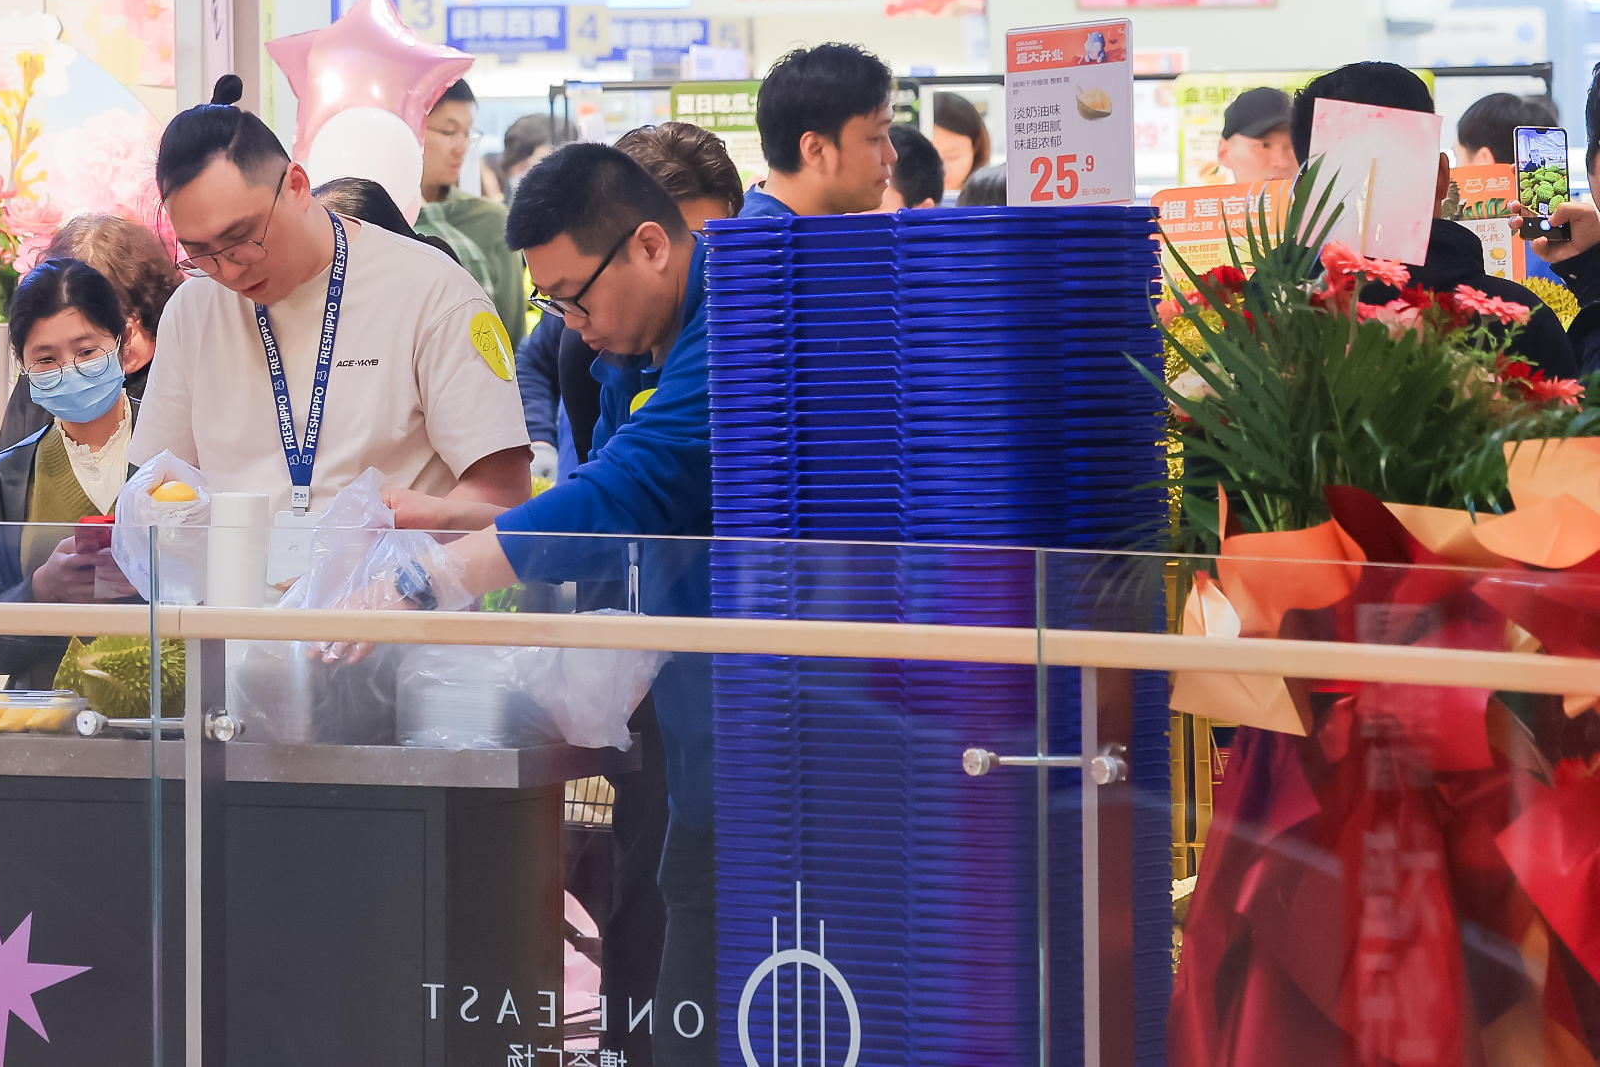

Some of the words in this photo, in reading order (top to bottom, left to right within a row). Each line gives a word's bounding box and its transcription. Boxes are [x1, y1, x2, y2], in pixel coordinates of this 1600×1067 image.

[577, 13, 600, 44] 4
[1016, 48, 1064, 65] 盛大开业
[1013, 104, 1061, 120] 淡奶油味
[1014, 120, 1061, 136] 果肉细腻
[1014, 135, 1062, 151] 味超浓郁
[1485, 177, 1511, 189] 盒马
[332, 222, 346, 281] FRESHIPPO
[258, 316, 281, 376] FRESHIPPO
[319, 301, 338, 366] FRESHIPPO
[277, 394, 296, 450] FRESHIPPO
[305, 385, 324, 449] FRESHIPPO
